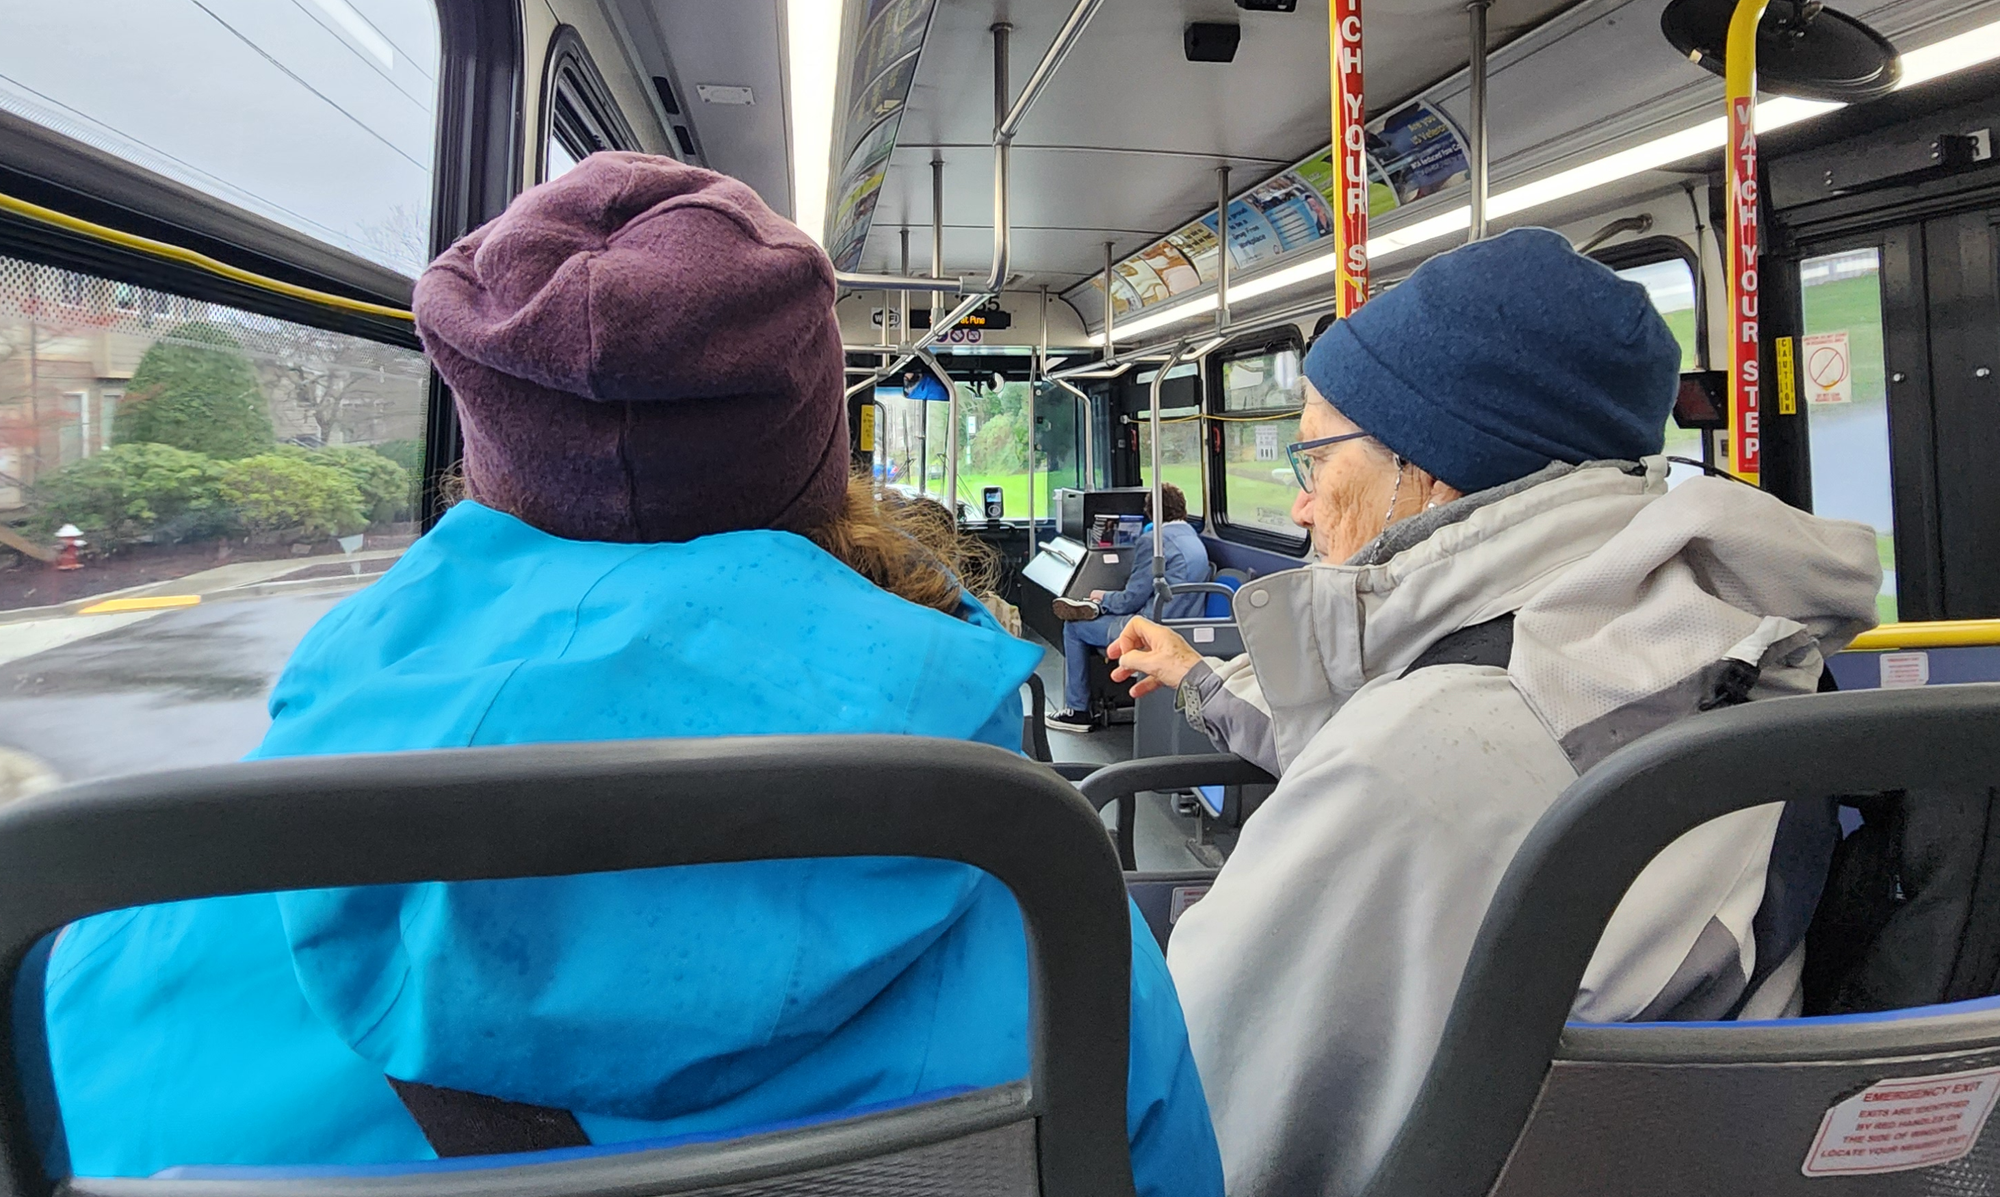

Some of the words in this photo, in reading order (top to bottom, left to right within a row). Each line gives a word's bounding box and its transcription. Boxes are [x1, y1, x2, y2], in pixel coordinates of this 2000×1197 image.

[1345, 94, 1366, 214] YOUR
[1232, 230, 1247, 240] Drug
[1245, 225, 1260, 235] Free
[1348, 245, 1367, 314] ST
[1741, 244, 1758, 342] YOUR
[1781, 339, 1790, 411] CAUTION
[1743, 361, 1759, 459] STEP
[1864, 1086, 1949, 1102] EMERGENCY
[1952, 1081, 1983, 1094] EXIT
[1856, 1122, 1871, 1131] BY
[1873, 1121, 1896, 1129] RED
[1946, 1113, 1963, 1121] ON
[1858, 1109, 1889, 1118] EXITS
[1892, 1107, 1913, 1116] ARE
[1843, 1135, 1865, 1143] THE
[1867, 1133, 1892, 1143] SIDE
[1894, 1131, 1908, 1140] OF
[1821, 1148, 1867, 1158] LOCATE
[1868, 1145, 1900, 1156] YOUR
